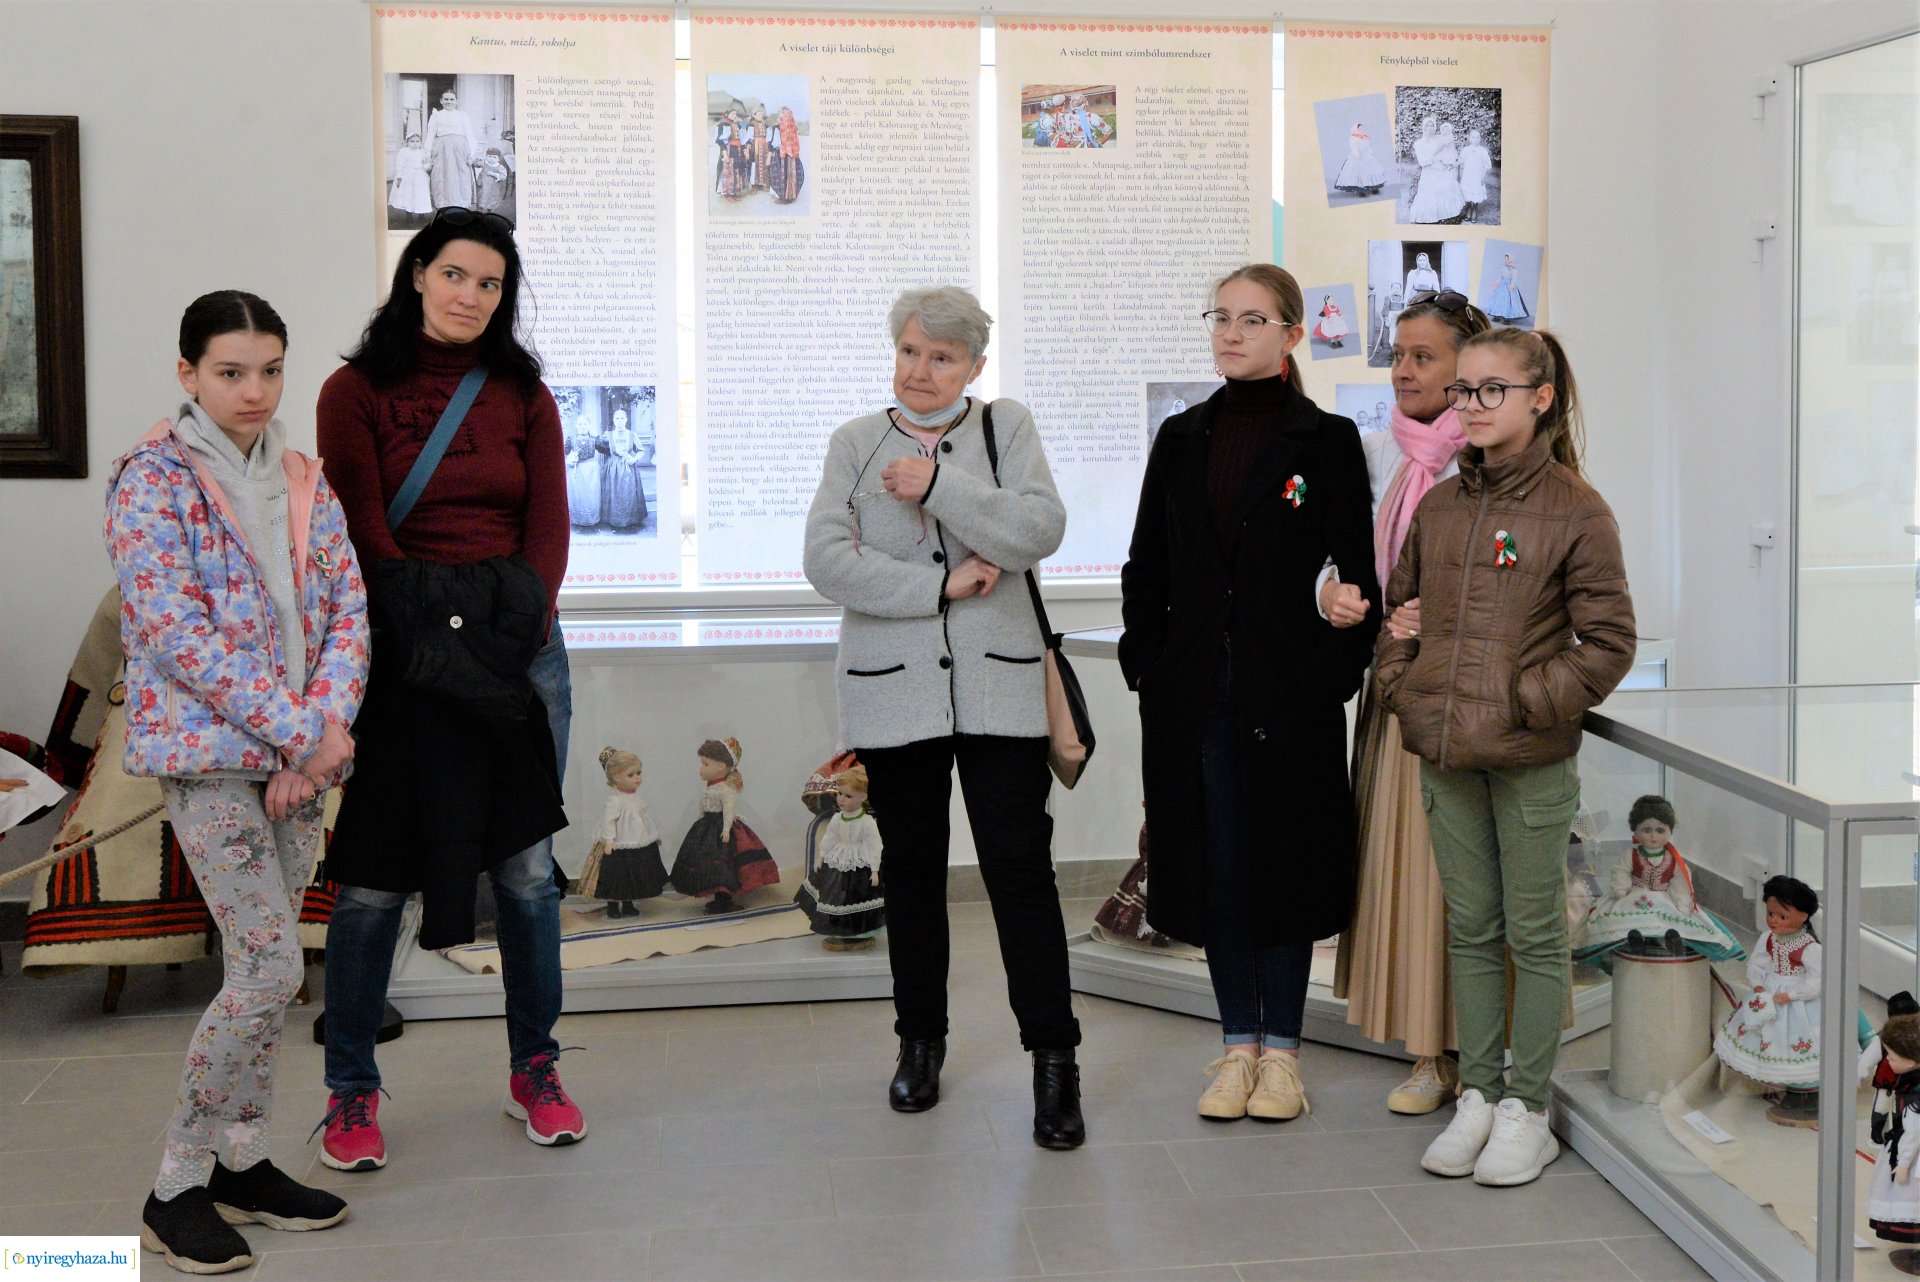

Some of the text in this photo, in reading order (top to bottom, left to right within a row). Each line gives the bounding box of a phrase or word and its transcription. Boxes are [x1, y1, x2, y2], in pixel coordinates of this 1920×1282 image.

[470, 35, 576, 48] Kantus, mizli, rokolya
[779, 43, 894, 56] A viselet táji különbségei
[1060, 47, 1211, 57] A viselet mint szimbólumrendszer
[1380, 55, 1458, 68] Fényképből viselet
[537, 76, 588, 86] különlegesen
[594, 76, 621, 87] csengő
[837, 75, 876, 85] magyarság
[886, 76, 911, 86] gazdag
[527, 87, 554, 97] melyek
[558, 87, 593, 98] jelentését
[597, 87, 636, 98] manapság
[820, 86, 859, 96] mányában
[931, 88, 969, 96] falvanként
[1145, 85, 1158, 95] régi
[527, 101, 547, 109] egyre
[554, 98, 584, 107] kevésbé
[633, 99, 654, 110] Pedig
[846, 98, 876, 106] viseletek
[881, 98, 914, 106] alakultak
[527, 110, 553, 120] egykor
[631, 110, 654, 119] voltak
[821, 108, 849, 116] vidékek
[864, 109, 892, 119] például
[897, 109, 921, 117] Sárköz
[1136, 107, 1159, 117] egykor
[1163, 107, 1187, 117] jelként
[588, 121, 612, 130] hiszen
[851, 120, 875, 130] erdélyi
[879, 120, 918, 130] Kalotaszeg
[528, 132, 545, 143] napi
[551, 132, 617, 141] öltözetdarabokat
[821, 131, 969, 142] öltözetei között jelentős különbségek
[1136, 139, 1147, 149] járt
[1189, 140, 1207, 149] hogy
[1216, 140, 1241, 150] viselője
[528, 155, 566, 165] kislányok
[617, 155, 632, 164] által
[557, 167, 586, 175] hordott
[821, 164, 860, 172] eltéréseket
[905, 165, 931, 175] például
[944, 165, 969, 173] kendőt
[529, 211, 569, 222] bőszoknya
[607, 212, 655, 222] megnevezése
[706, 230, 738, 238] tökéletes
[744, 230, 790, 240] biztonsággal
[816, 230, 840, 238] tudták
[887, 231, 904, 241] hogy
[921, 231, 938, 239] hova
[1130, 237, 1153, 247] állapot
[1157, 237, 1205, 247] megváltozását
[542, 314, 581, 324] bonyolult
[583, 314, 612, 322] szabású
[615, 314, 643, 322] felsőket
[603, 370, 647, 378] alkalomhoz
[1085, 400, 1122, 410] asszonyok
[708, 497, 731, 507] éppen
[738, 497, 756, 507] hogy
[762, 497, 798, 505] beleolvad
